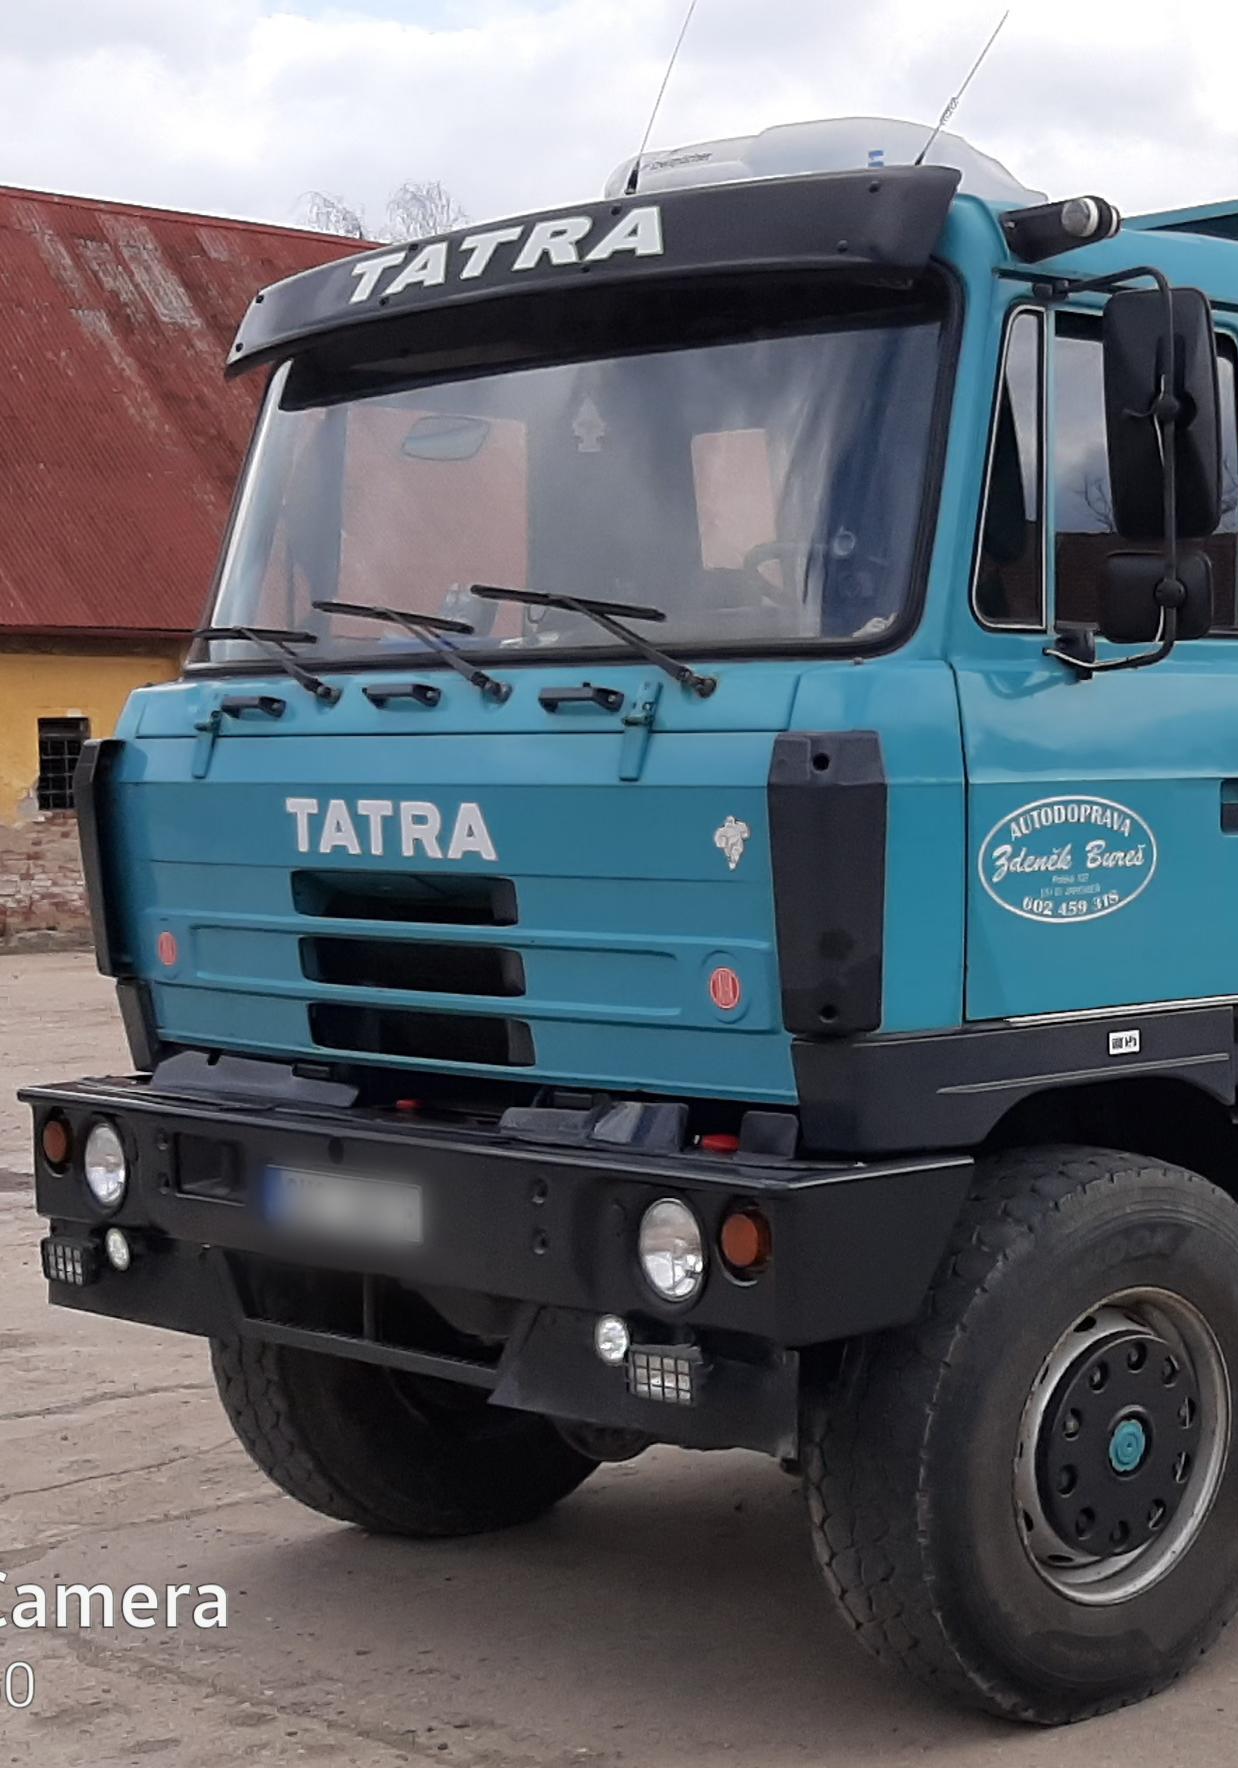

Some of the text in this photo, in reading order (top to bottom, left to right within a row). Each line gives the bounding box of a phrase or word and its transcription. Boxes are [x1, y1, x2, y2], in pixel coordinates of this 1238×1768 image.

[350, 206, 664, 304] TATRA
[285, 797, 499, 861] TATRA
[1009, 803, 1132, 841] AUTODOPRAVA
[991, 843, 1073, 884] Zdeněk
